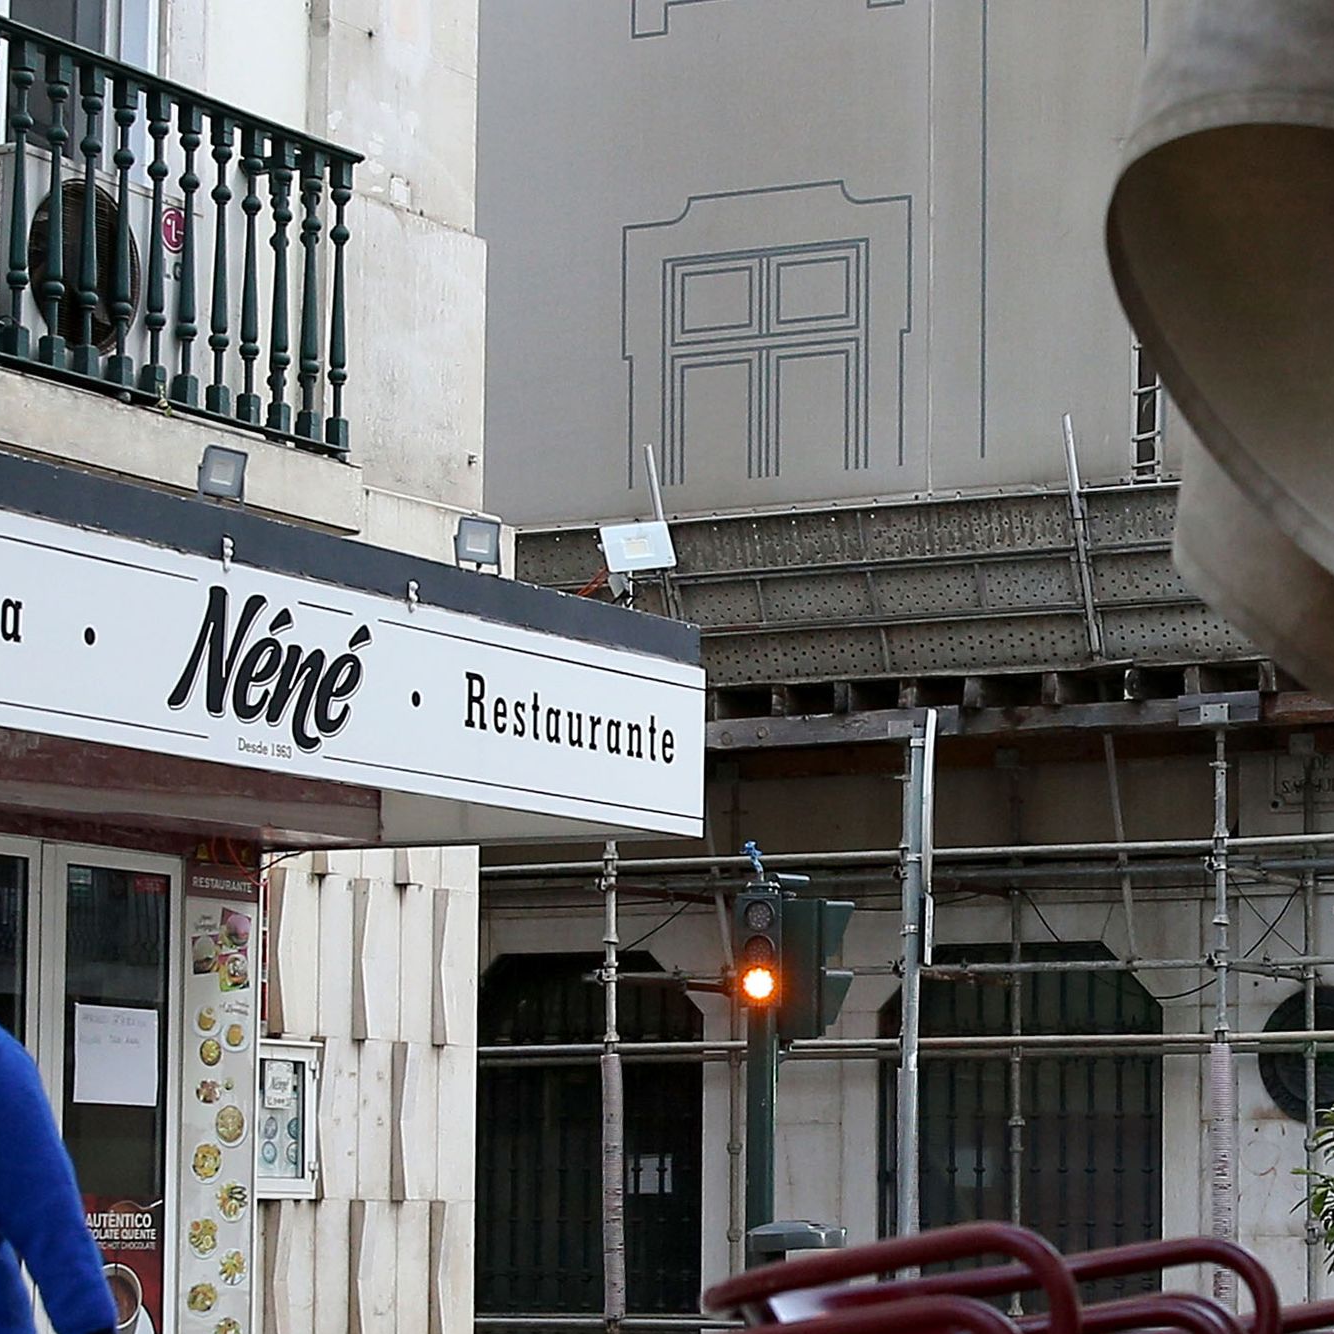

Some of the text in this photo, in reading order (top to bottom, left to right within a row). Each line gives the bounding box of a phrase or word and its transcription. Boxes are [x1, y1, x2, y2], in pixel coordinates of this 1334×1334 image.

[167, 586, 372, 753] Néné
[465, 671, 674, 764] Restaurante
[238, 737, 268, 755] Desde
[192, 876, 253, 894] RESTAURANTE
[85, 1210, 153, 1228] AUTÊNTICO
[121, 1228, 157, 1240] QUENTE
